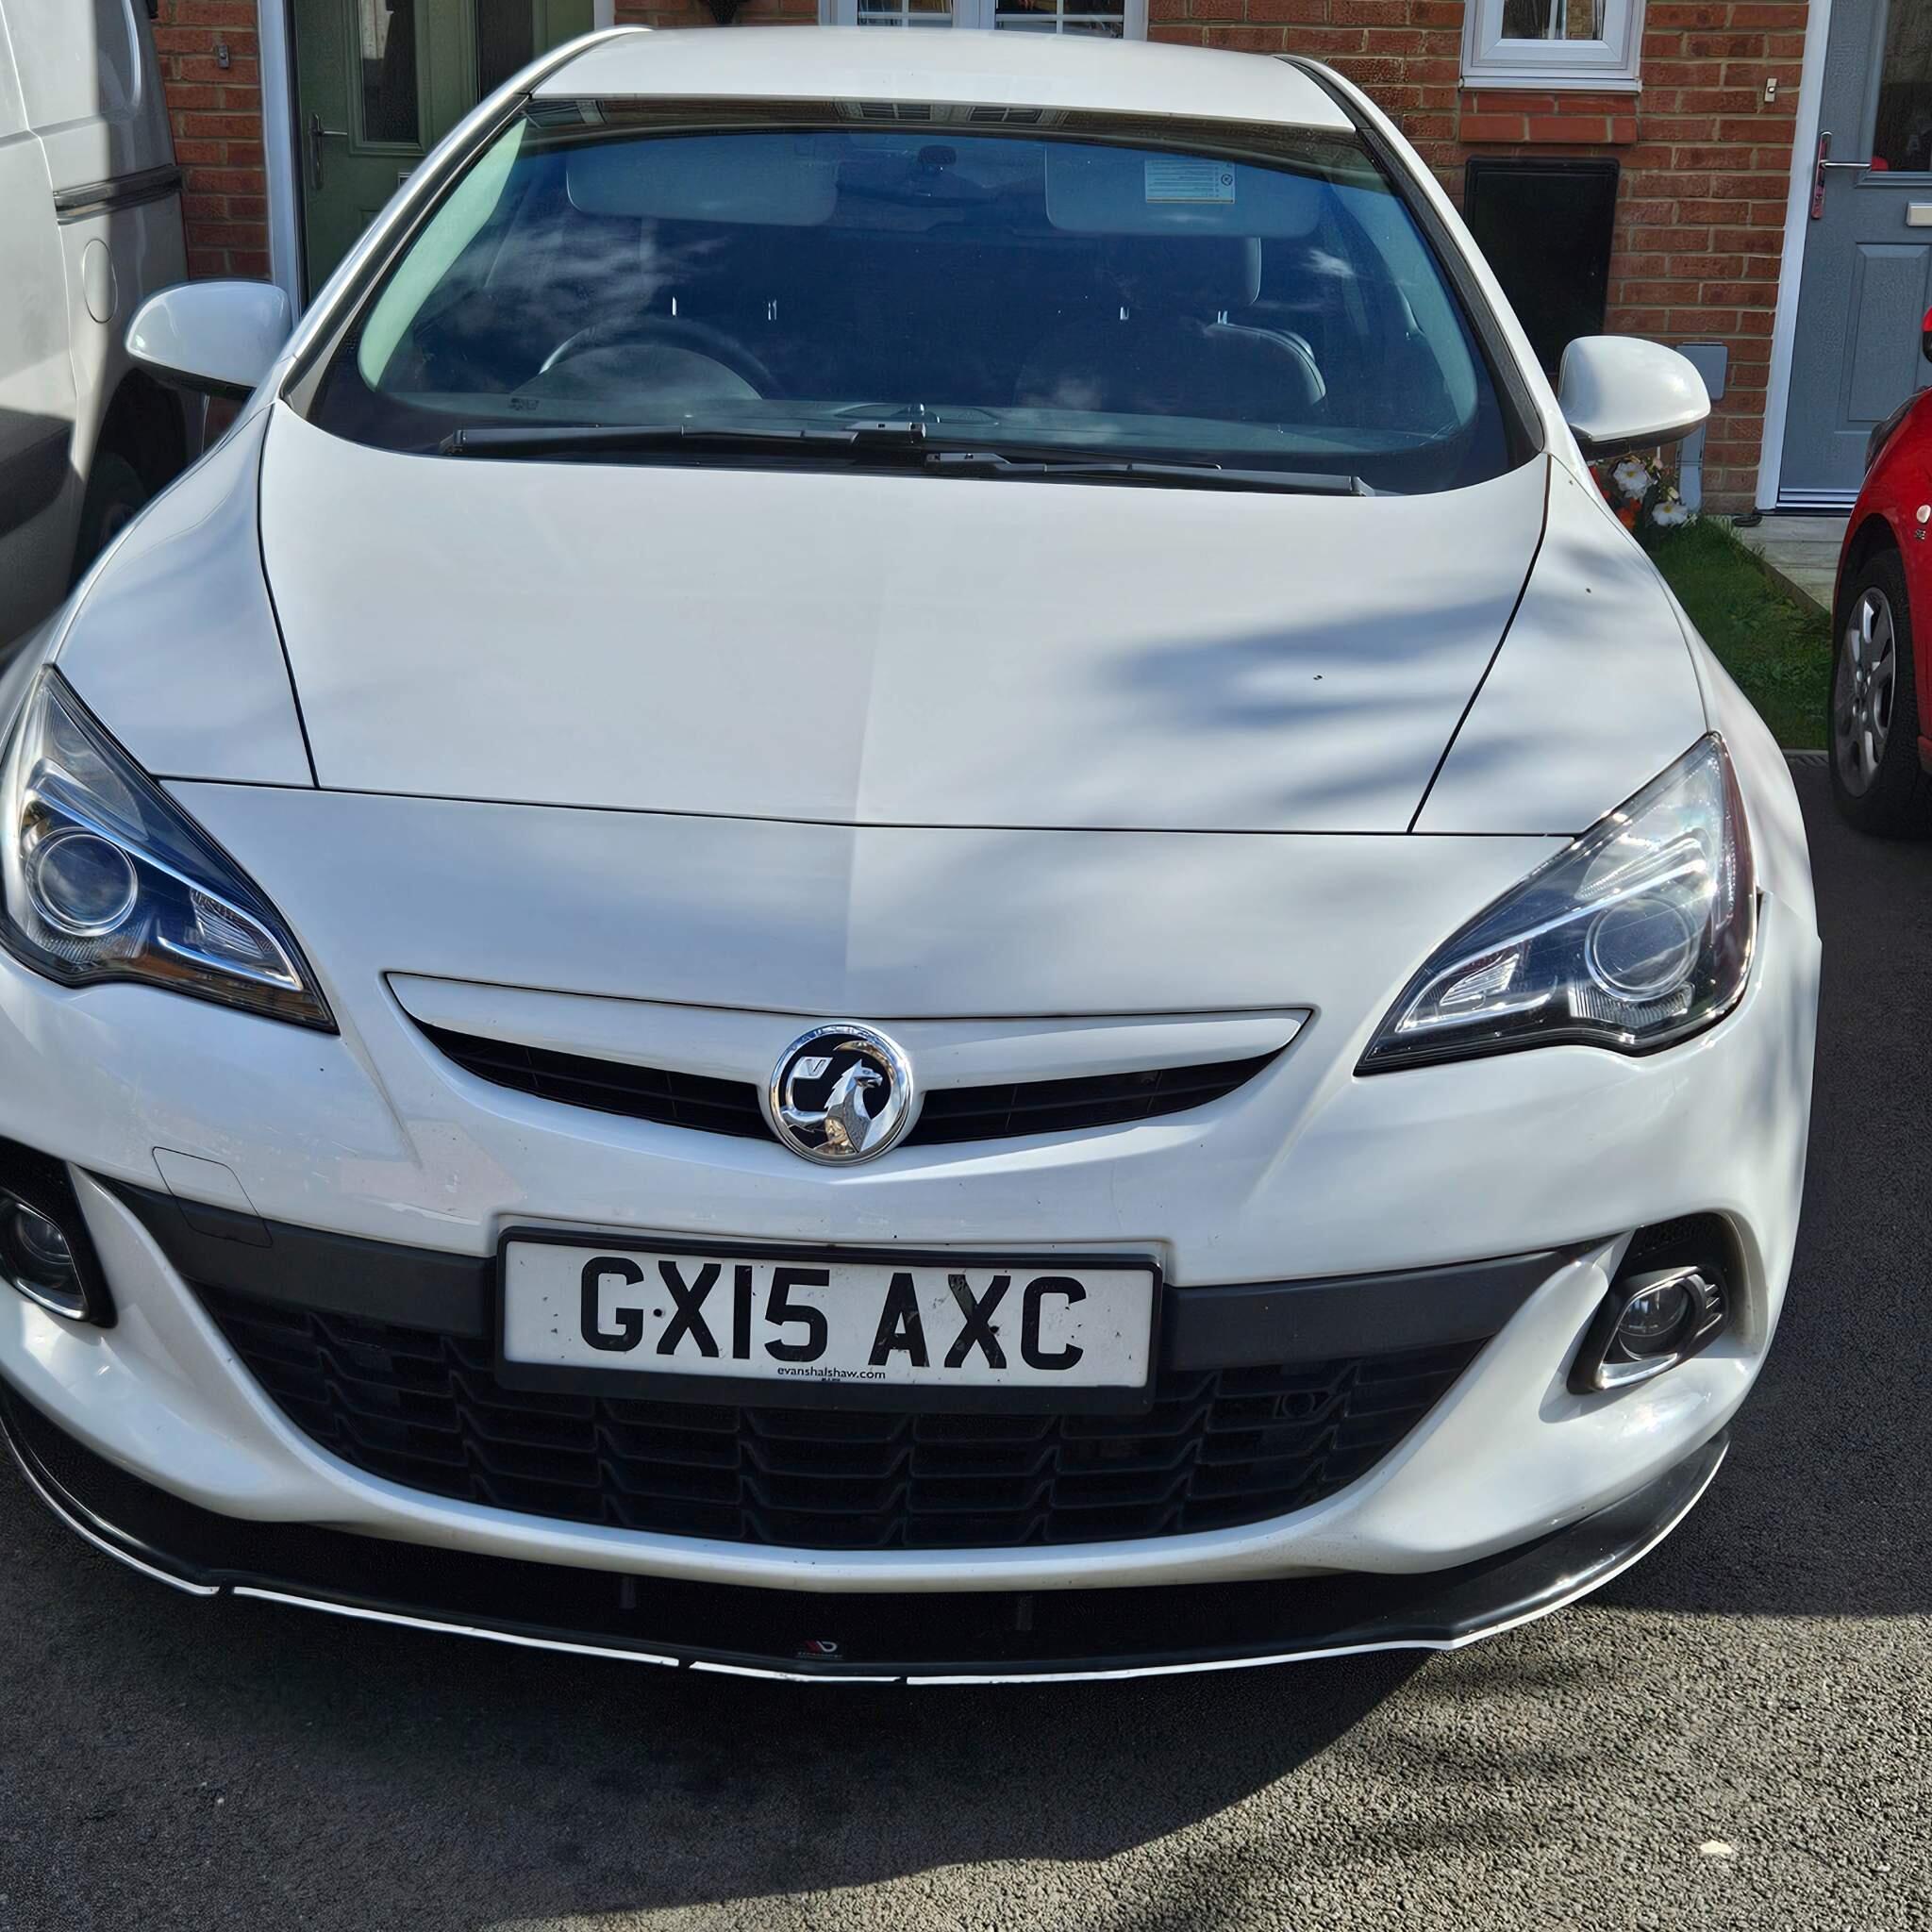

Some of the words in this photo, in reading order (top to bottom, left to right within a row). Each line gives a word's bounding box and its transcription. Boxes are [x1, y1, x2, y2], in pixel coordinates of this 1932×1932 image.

[580, 1256, 831, 1363] GX15
[868, 1272, 1087, 1371] AXC
[776, 1366, 886, 1379] evanshalshaw.com
